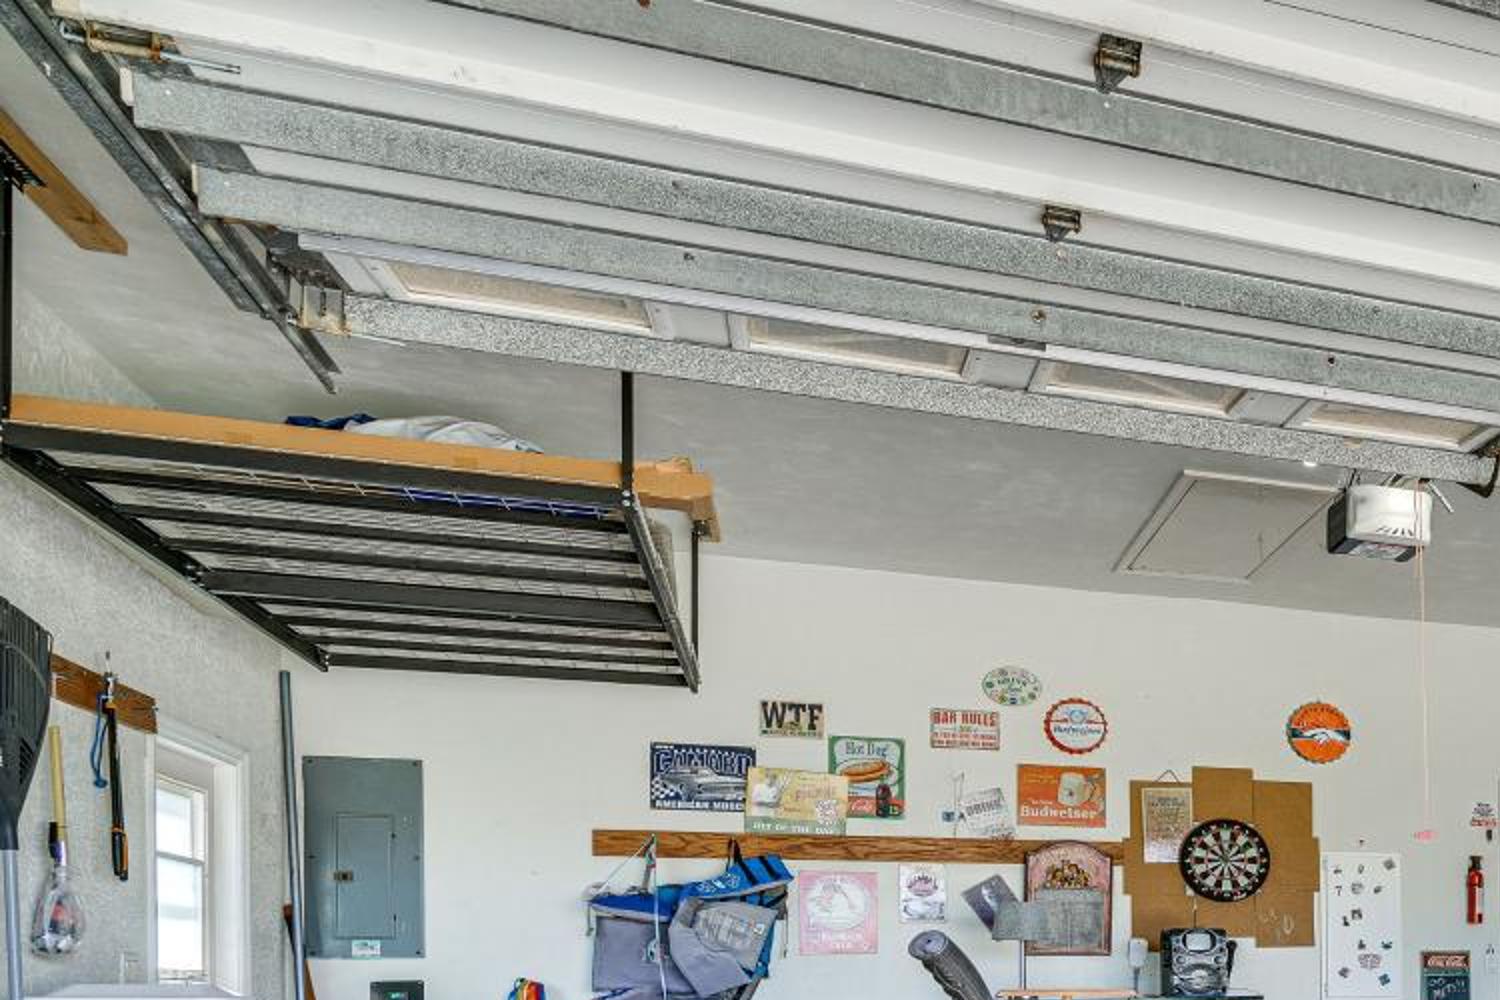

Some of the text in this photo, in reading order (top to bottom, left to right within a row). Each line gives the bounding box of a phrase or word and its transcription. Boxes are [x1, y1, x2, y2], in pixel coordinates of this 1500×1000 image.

[761, 701, 823, 731] WTF
[933, 711, 957, 725] BAR
[713, 800, 746, 811] MUSC
[1020, 804, 1102, 819] Budweiser
